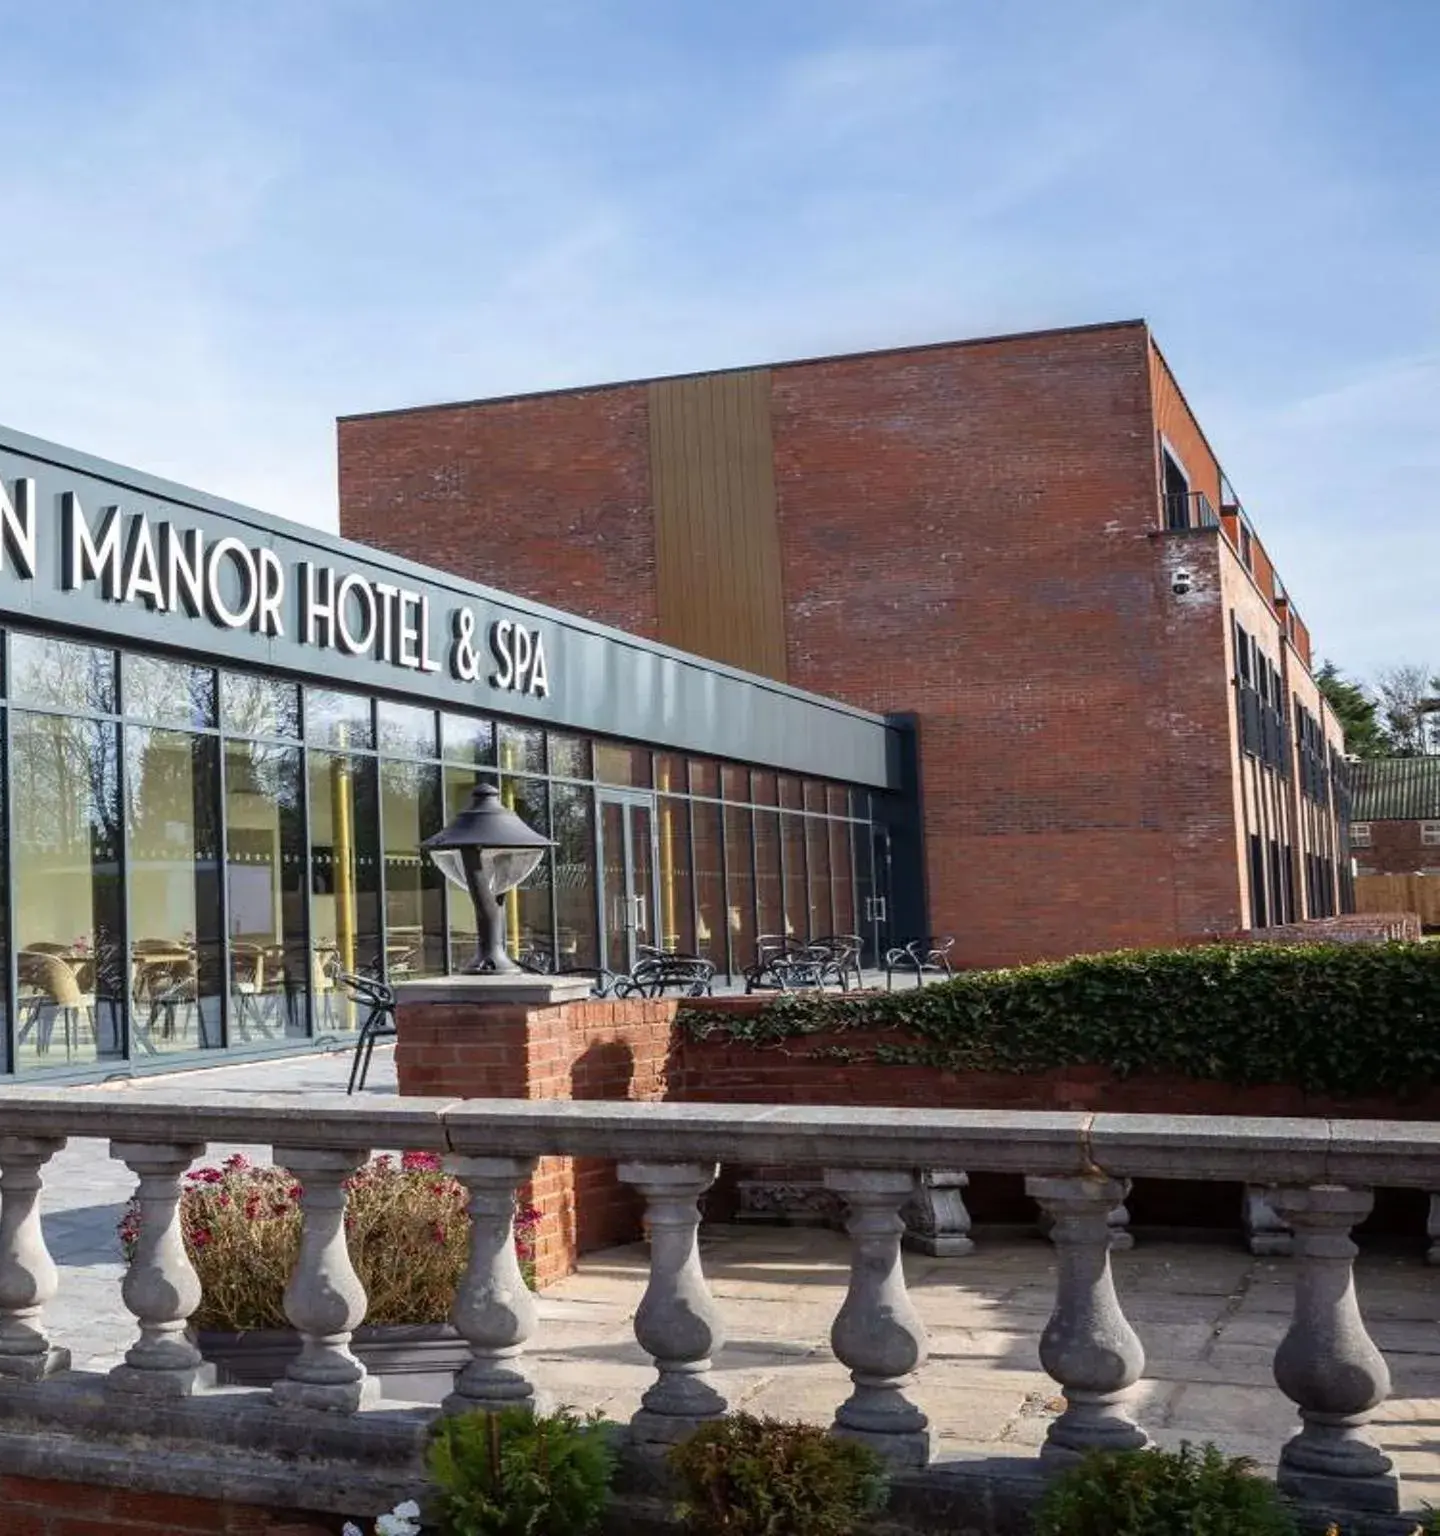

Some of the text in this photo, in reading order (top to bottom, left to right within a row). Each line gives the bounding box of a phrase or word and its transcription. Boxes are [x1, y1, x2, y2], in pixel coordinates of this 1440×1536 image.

[68, 490, 285, 636] MANOR
[304, 561, 442, 672] HOTEL
[454, 605, 481, 682] &
[493, 620, 550, 698] SPA
